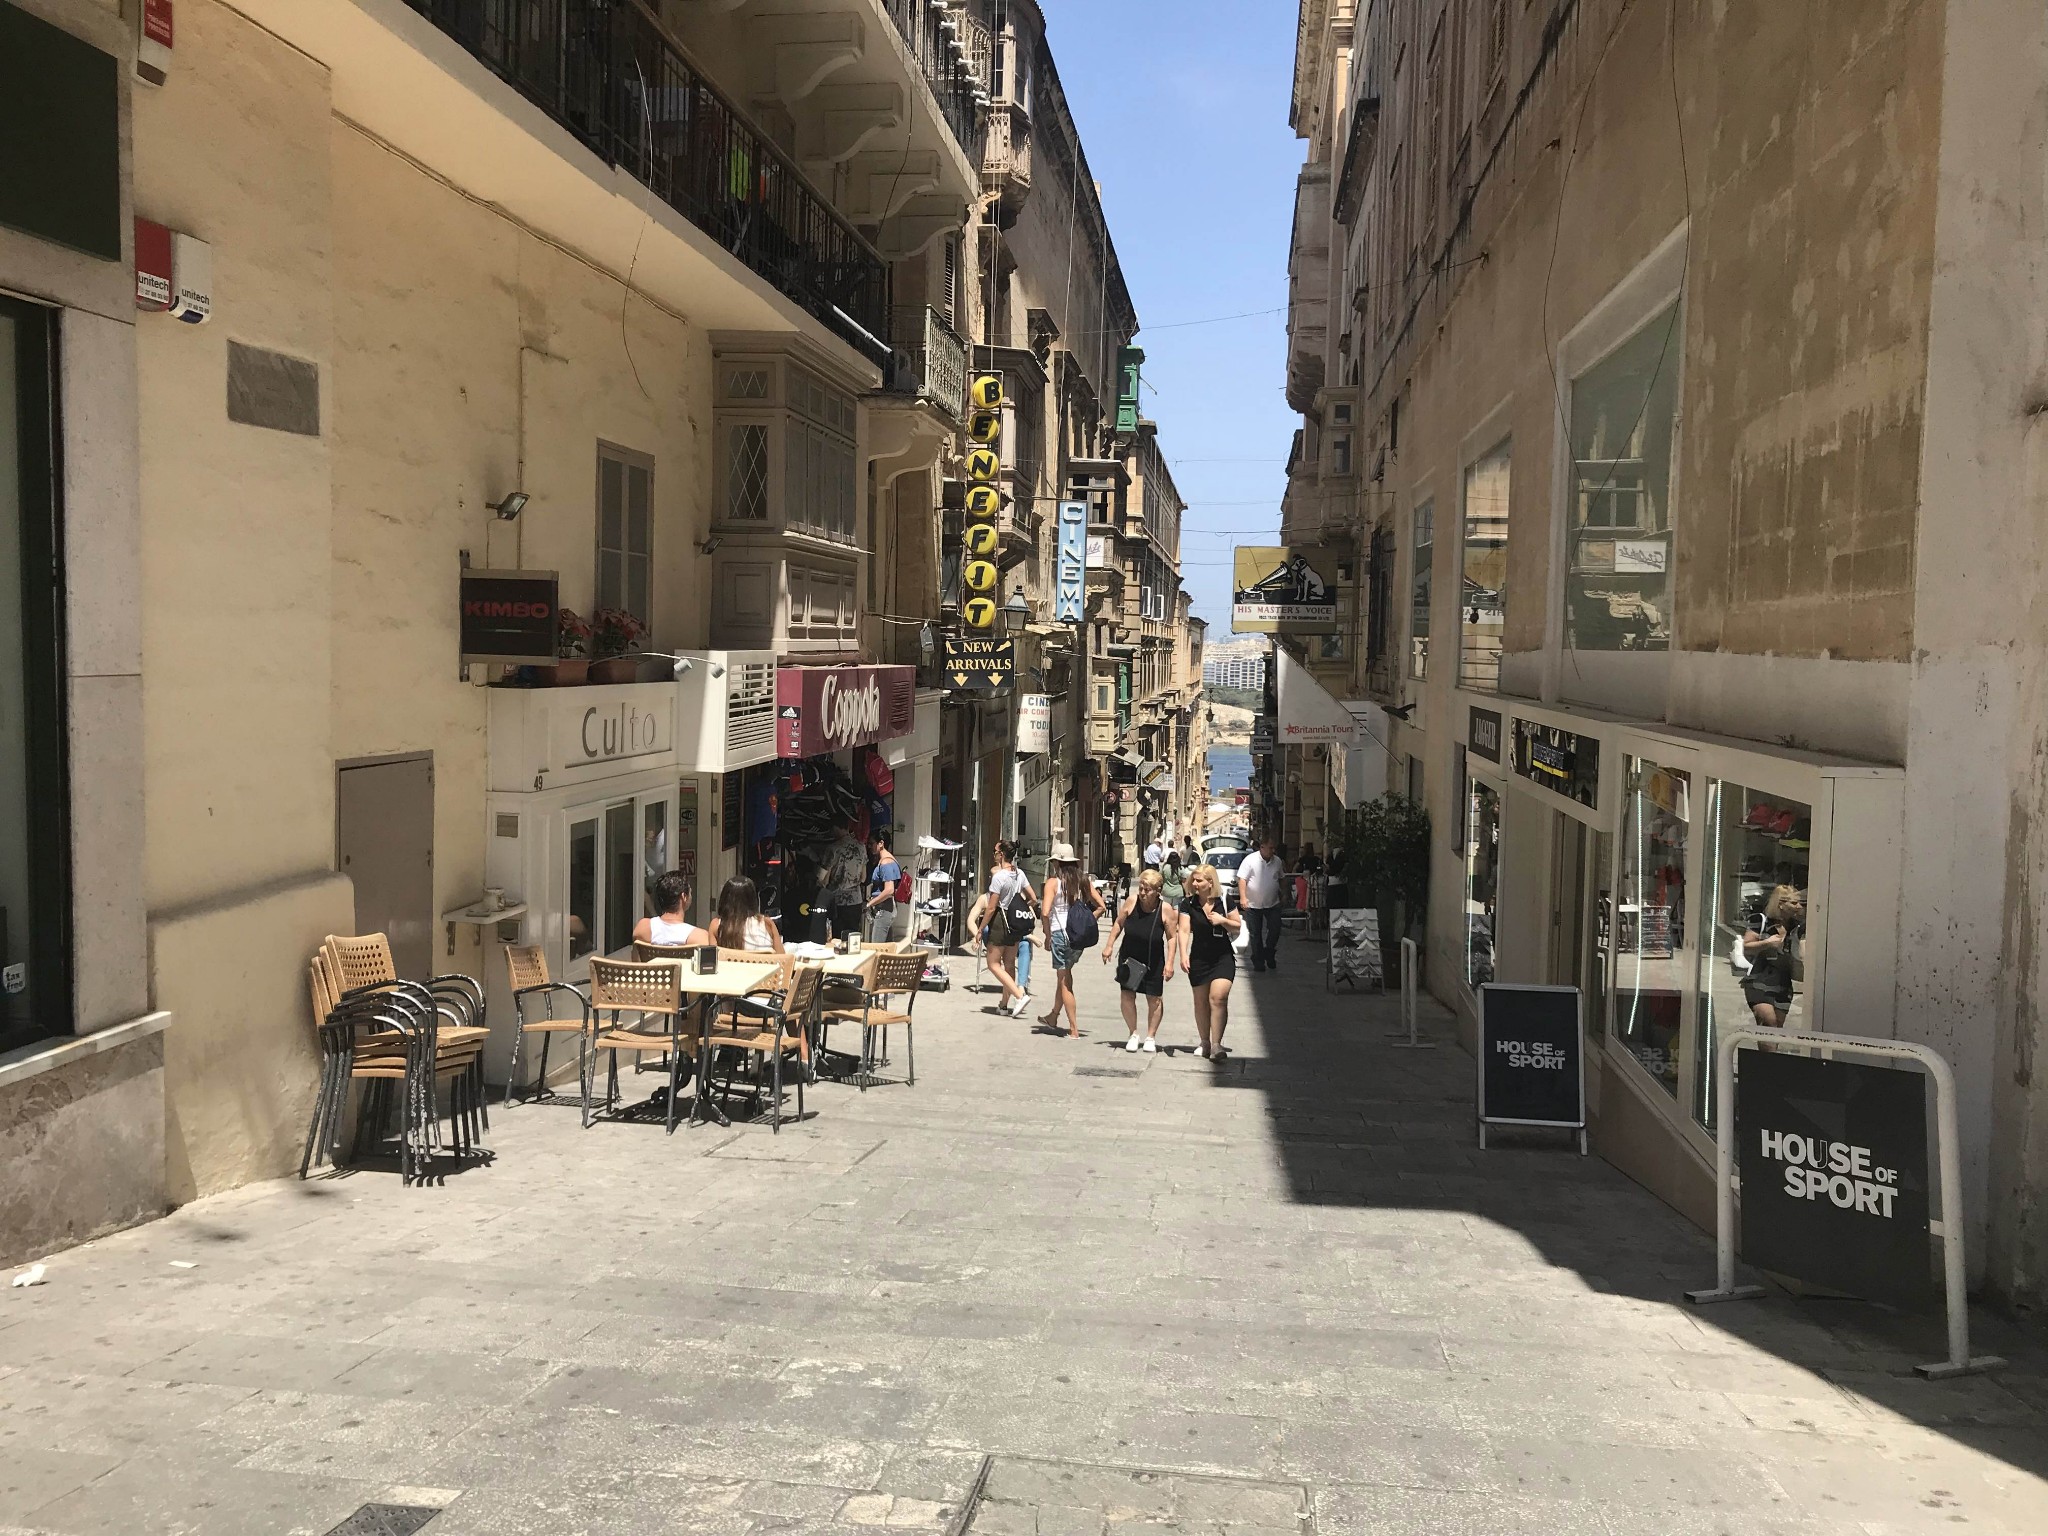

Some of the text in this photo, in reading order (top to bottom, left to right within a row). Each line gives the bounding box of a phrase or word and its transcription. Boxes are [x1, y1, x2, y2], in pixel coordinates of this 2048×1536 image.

[139, 275, 169, 291] unitech
[182, 289, 209, 305] unitech
[966, 378, 1002, 626] BENEFIT
[1060, 503, 1082, 620] CINEMA
[464, 601, 549, 618] KIMBO
[1237, 606, 1332, 615] HIS MASTER'S VOICE
[963, 641, 995, 653] NEW
[946, 659, 1012, 670] ARRIVALS
[822, 673, 880, 748] Coppola
[582, 702, 656, 758] Culto
[1030, 720, 1049, 730] TOD
[1295, 725, 1354, 734] Britannia Tours
[533, 775, 543, 791] 49
[1496, 1041, 1553, 1056] HOUSE
[1508, 1054, 1566, 1070] SPORT
[1761, 1128, 1898, 1184] HOUSE OF
[1783, 1165, 1899, 1219] SPORT
